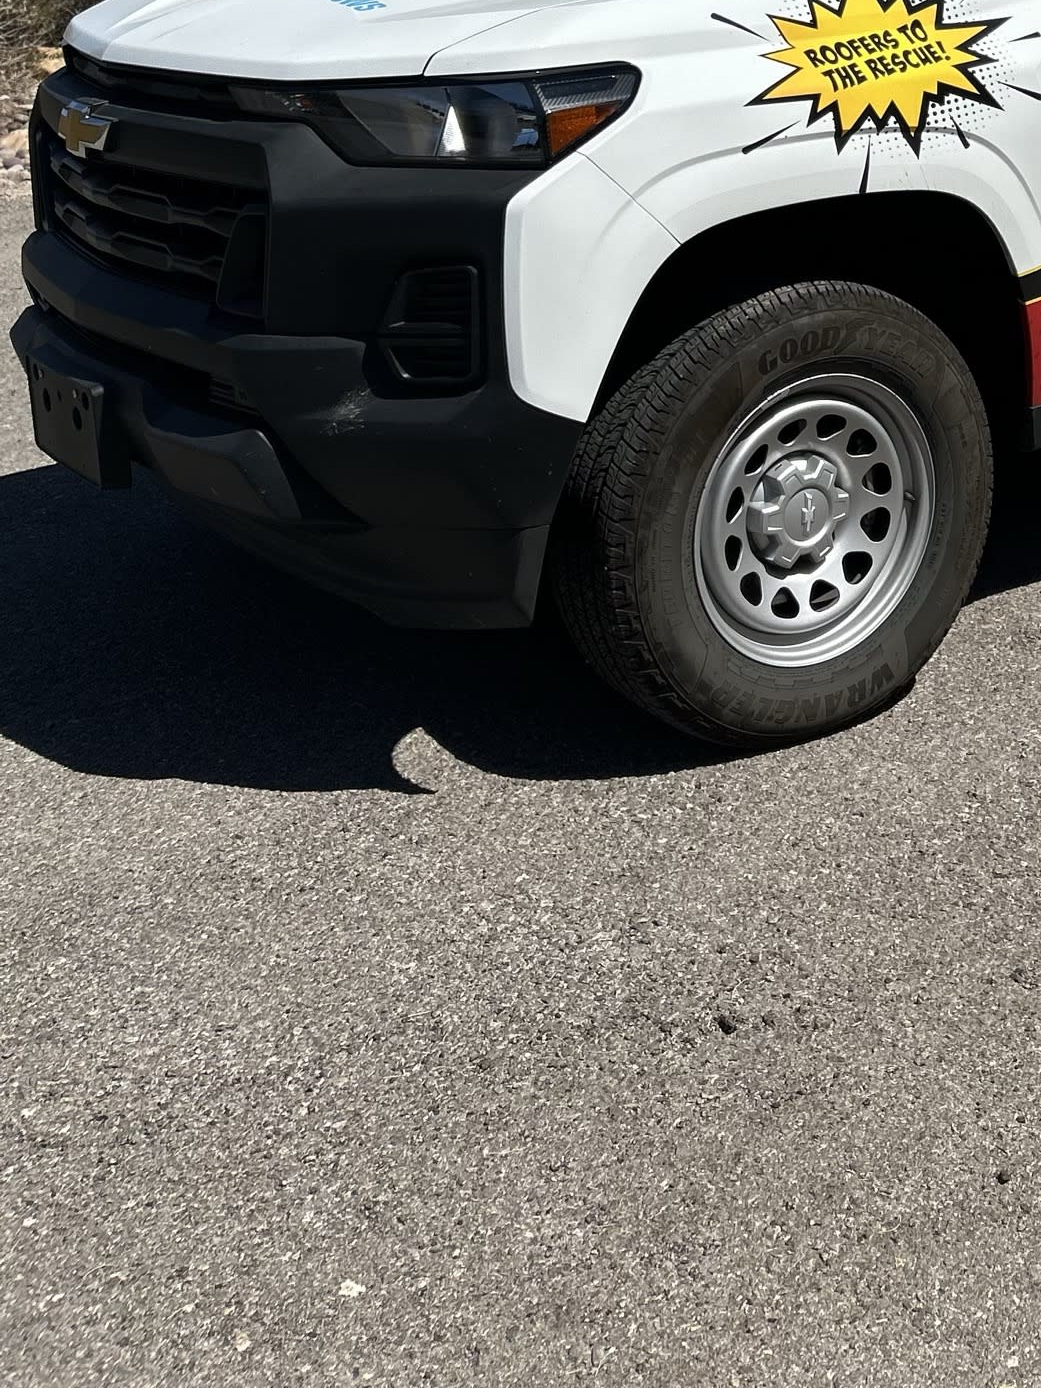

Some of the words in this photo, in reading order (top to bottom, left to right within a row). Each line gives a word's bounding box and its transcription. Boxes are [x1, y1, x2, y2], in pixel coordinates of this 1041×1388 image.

[803, 30, 899, 68] ROOFERS
[896, 18, 928, 45] TO
[821, 64, 866, 92] THE
[864, 40, 951, 79] RESCUE!
